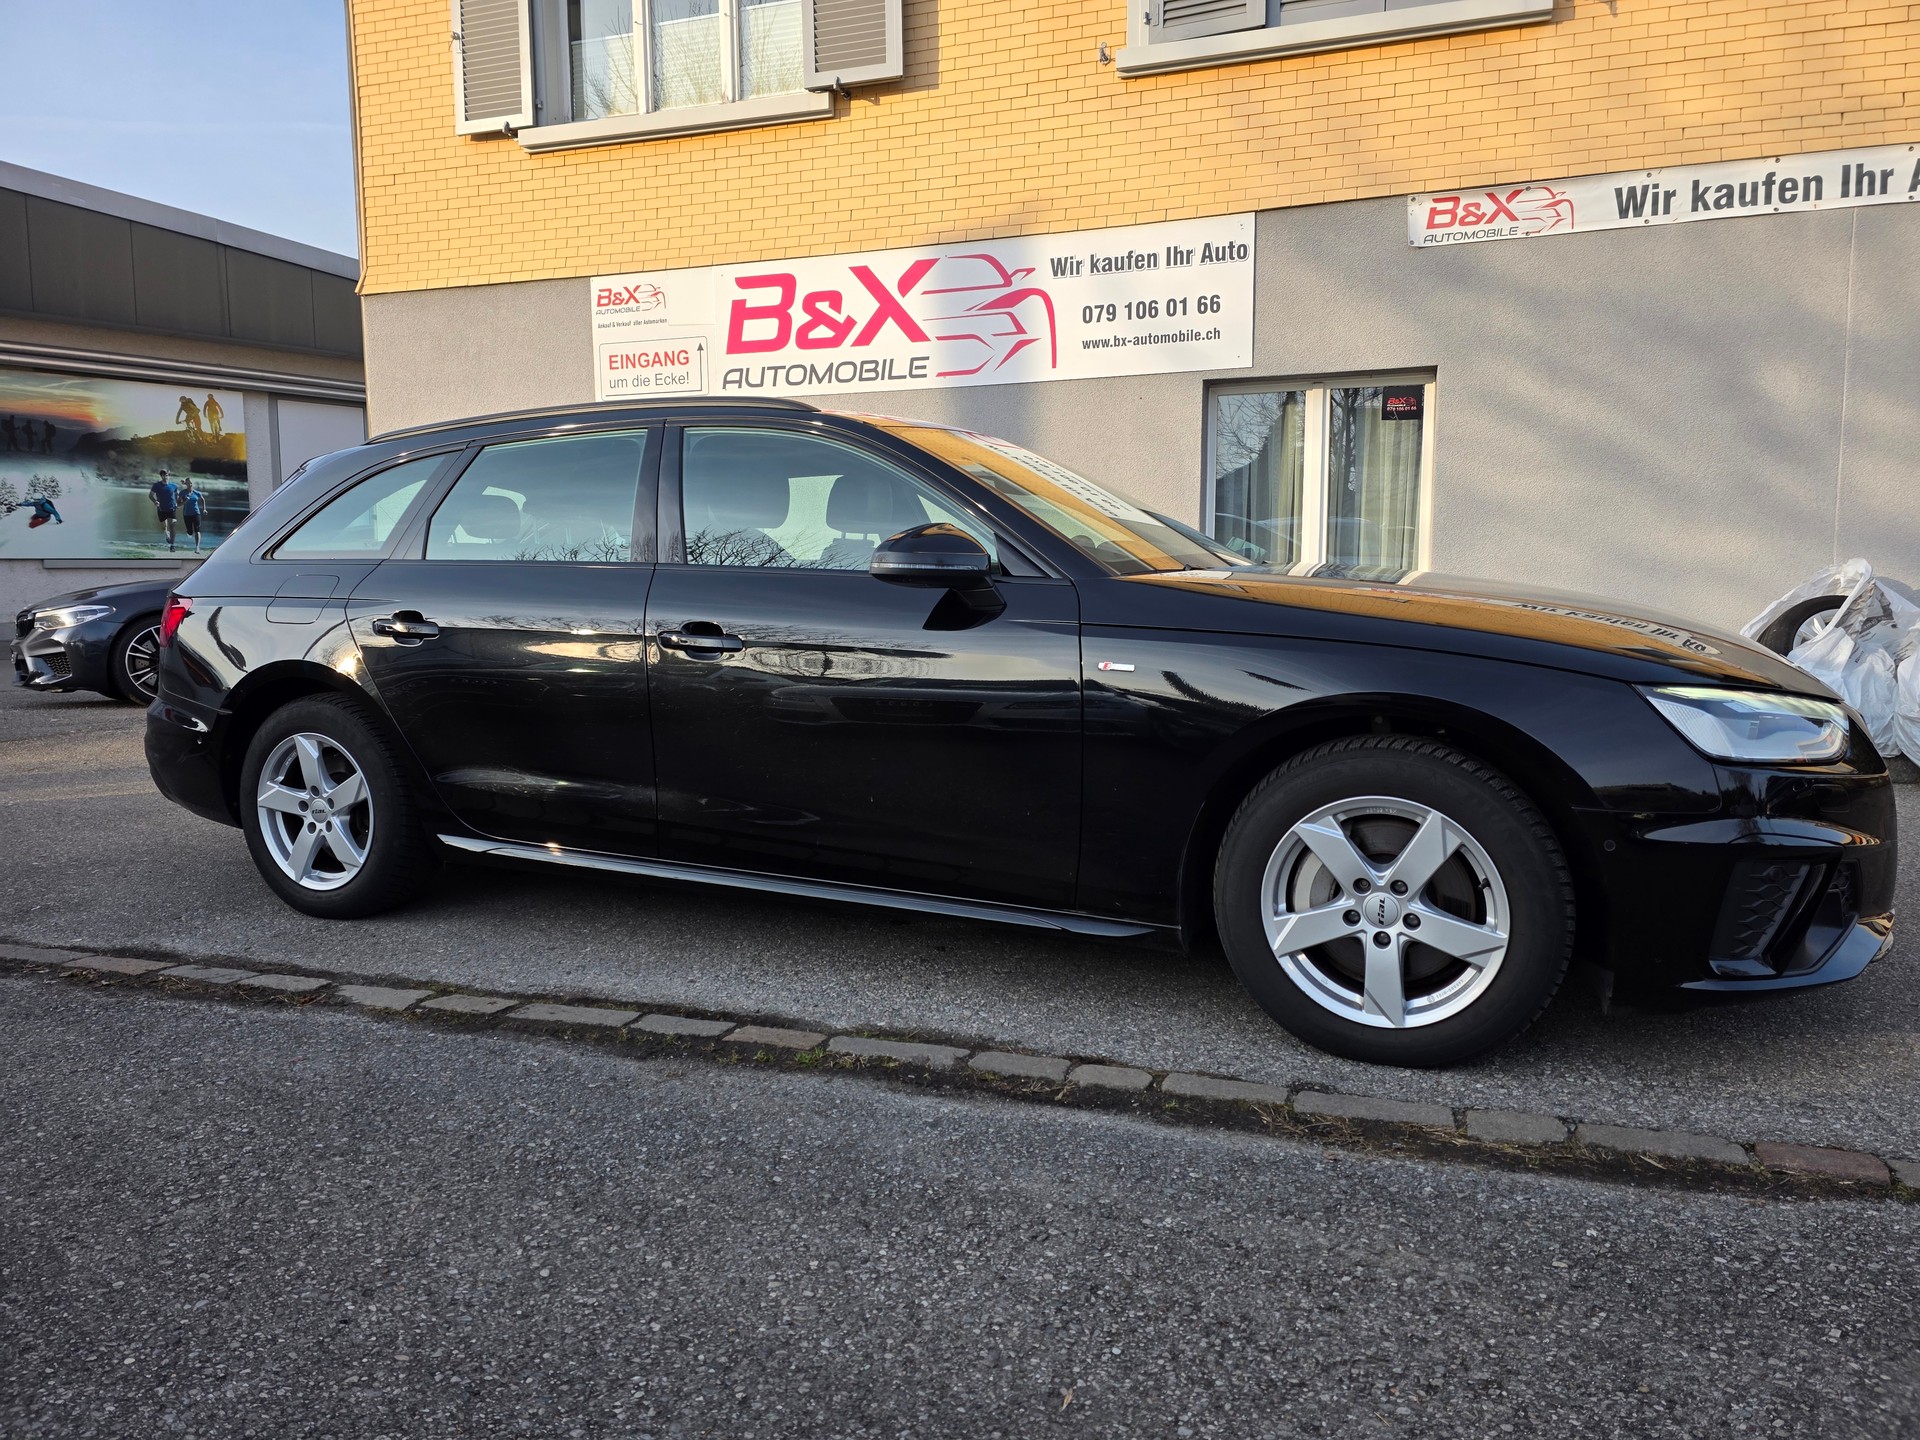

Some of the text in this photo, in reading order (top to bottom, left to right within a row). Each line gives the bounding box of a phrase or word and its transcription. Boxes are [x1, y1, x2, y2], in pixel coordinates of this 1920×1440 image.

[1614, 182, 1676, 219] Wir
[1690, 171, 1823, 213] kaufen
[1840, 162, 1895, 199] Ihr
[1426, 189, 1525, 230] B&X
[1423, 226, 1519, 244] AUTOMOBILE
[1050, 241, 1248, 278] Wir kaufen Ihr Auto
[597, 285, 641, 307] B&X
[726, 258, 941, 355] B&X
[1082, 294, 1221, 324] 079 106 01 66
[596, 306, 641, 316] AUTOMOBILE
[1082, 327, 1221, 349] www.bx-automobile.ch
[609, 349, 690, 370] EINGANG
[609, 371, 690, 389] um die Ecke!
[722, 356, 930, 390] AUTOMOBILE
